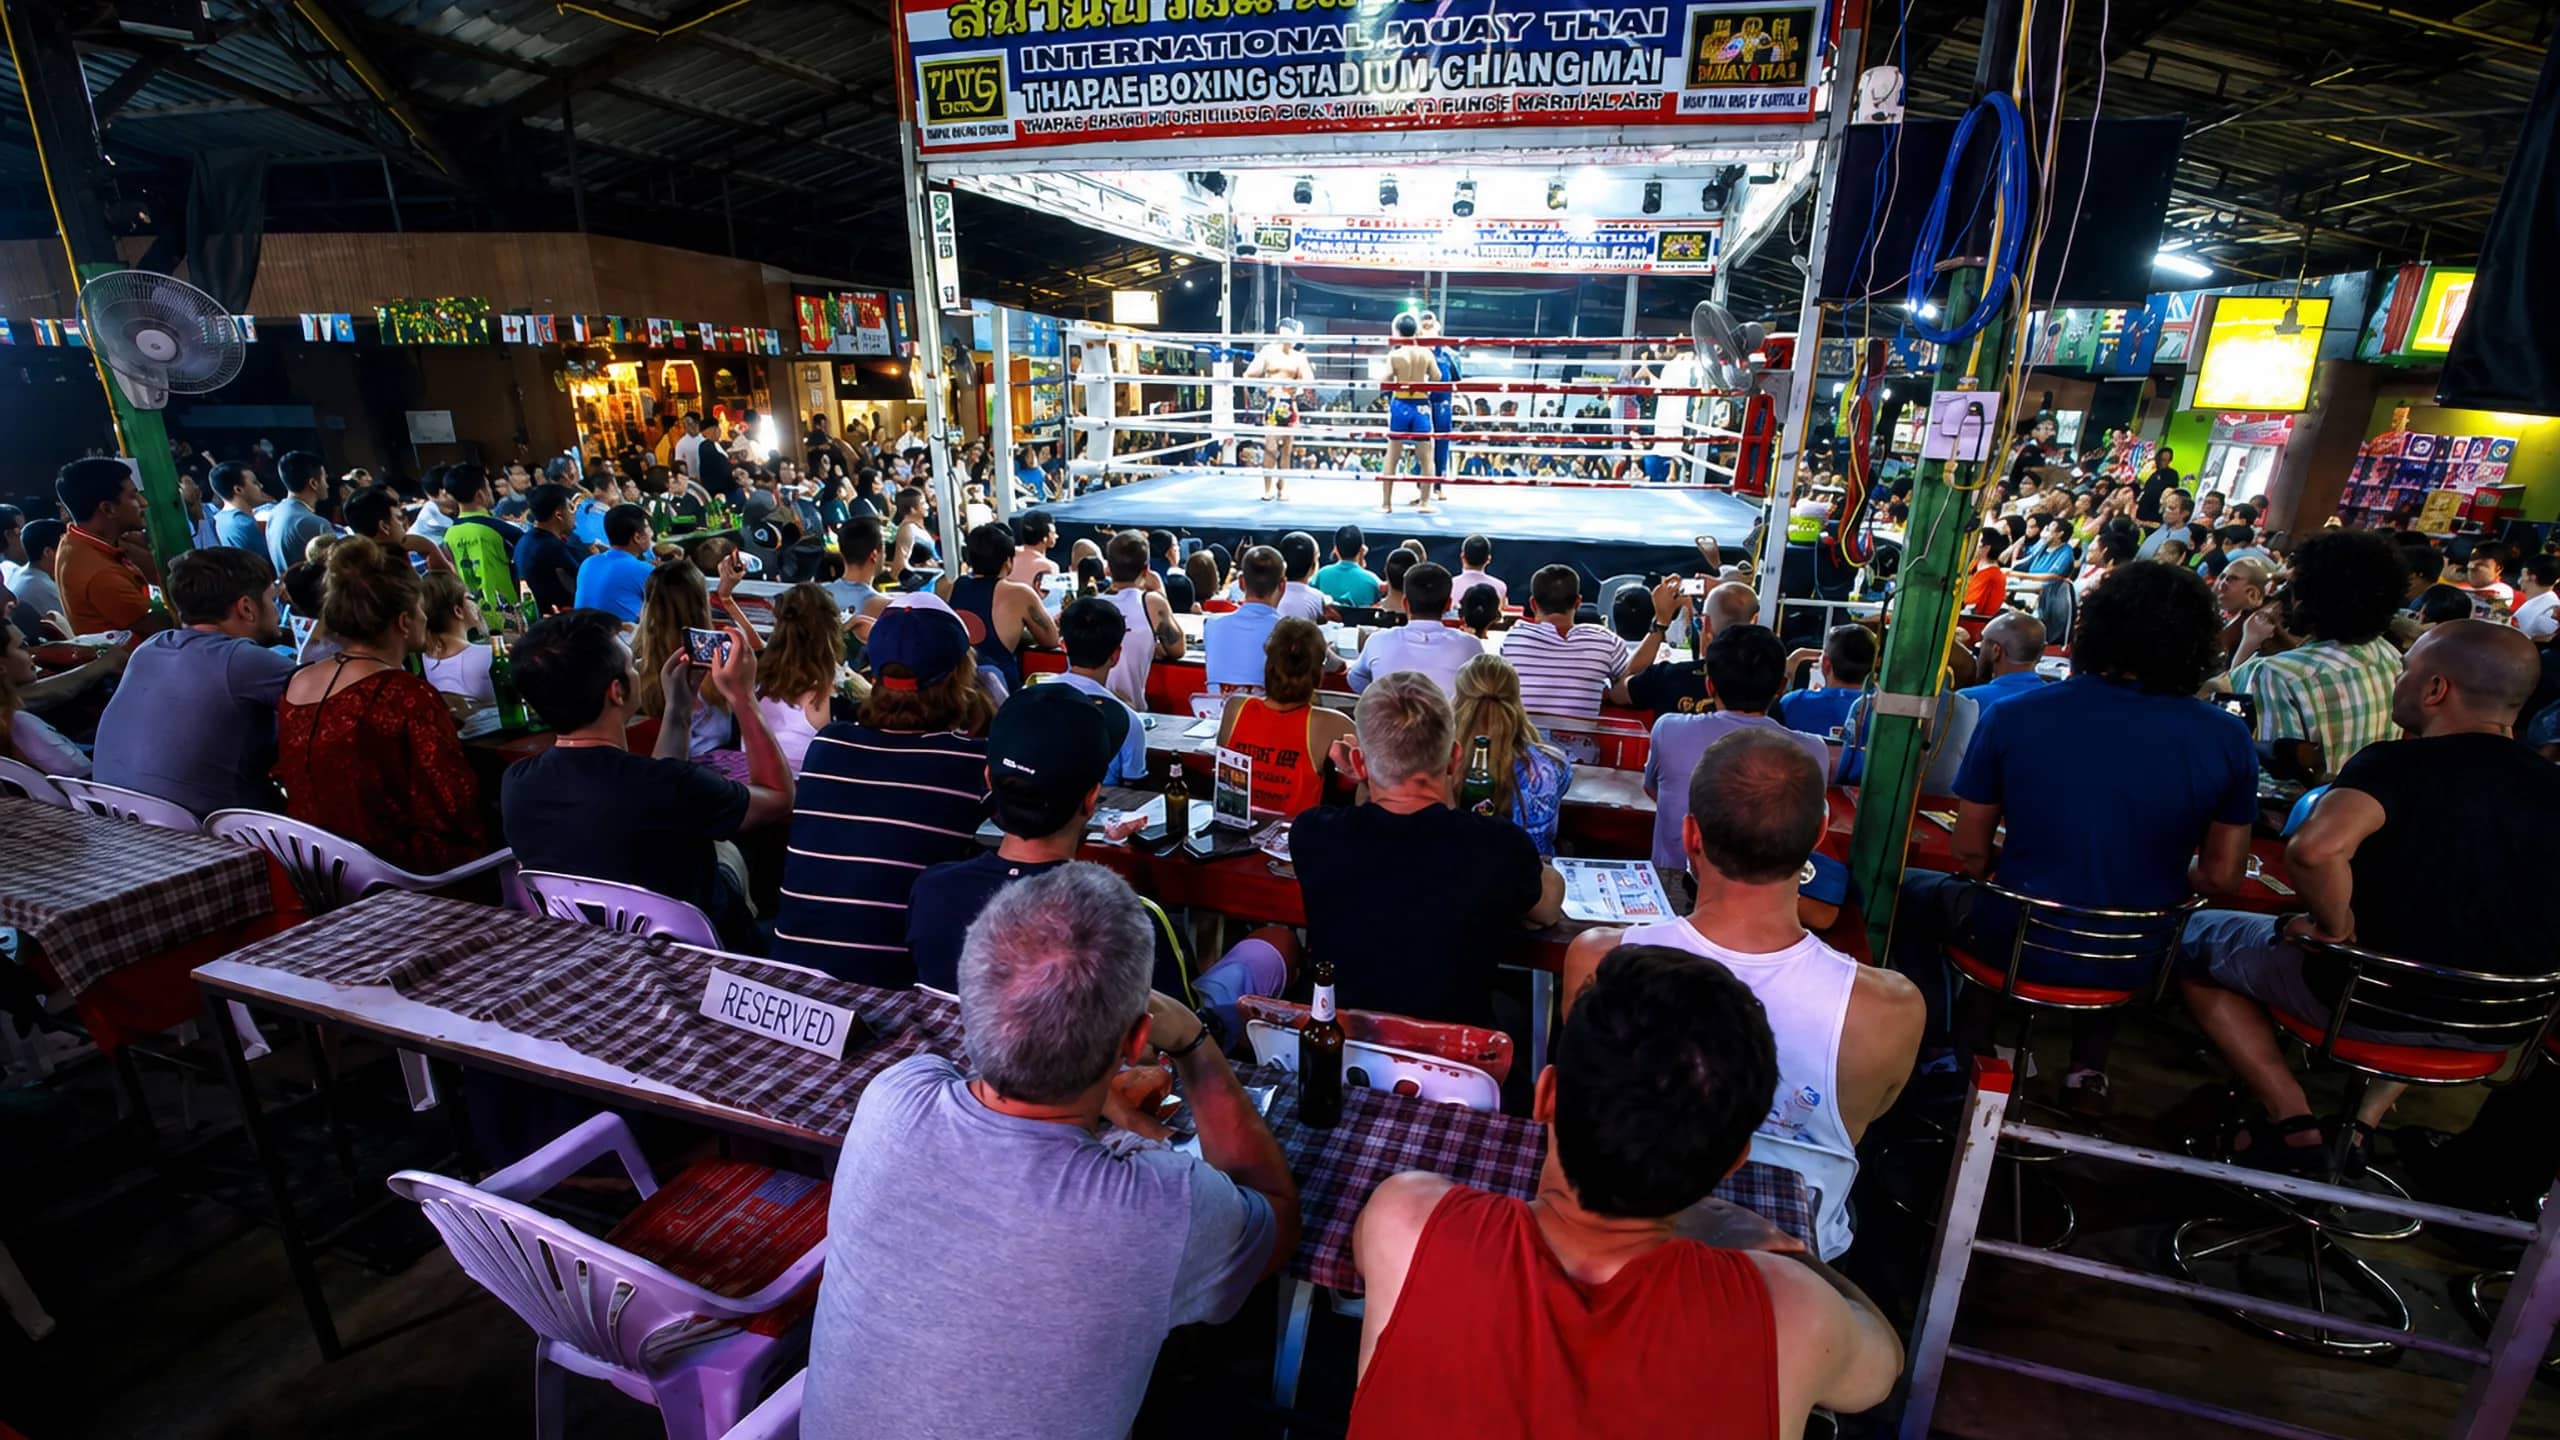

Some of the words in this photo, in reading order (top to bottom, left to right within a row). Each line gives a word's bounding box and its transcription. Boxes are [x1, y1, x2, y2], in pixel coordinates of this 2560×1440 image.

[1021, 24, 1374, 73] INTERNATIONAL
[1387, 13, 1535, 48] MUAY
[1545, 8, 1668, 40] THAI
[1022, 75, 1140, 112] THAPAE
[1147, 67, 1269, 105] BOXING
[1276, 57, 1430, 97] STADIUM
[1516, 93, 1614, 111] MARTIAL
[1617, 91, 1664, 110] ART
[720, 982, 835, 1046] RESERVED
